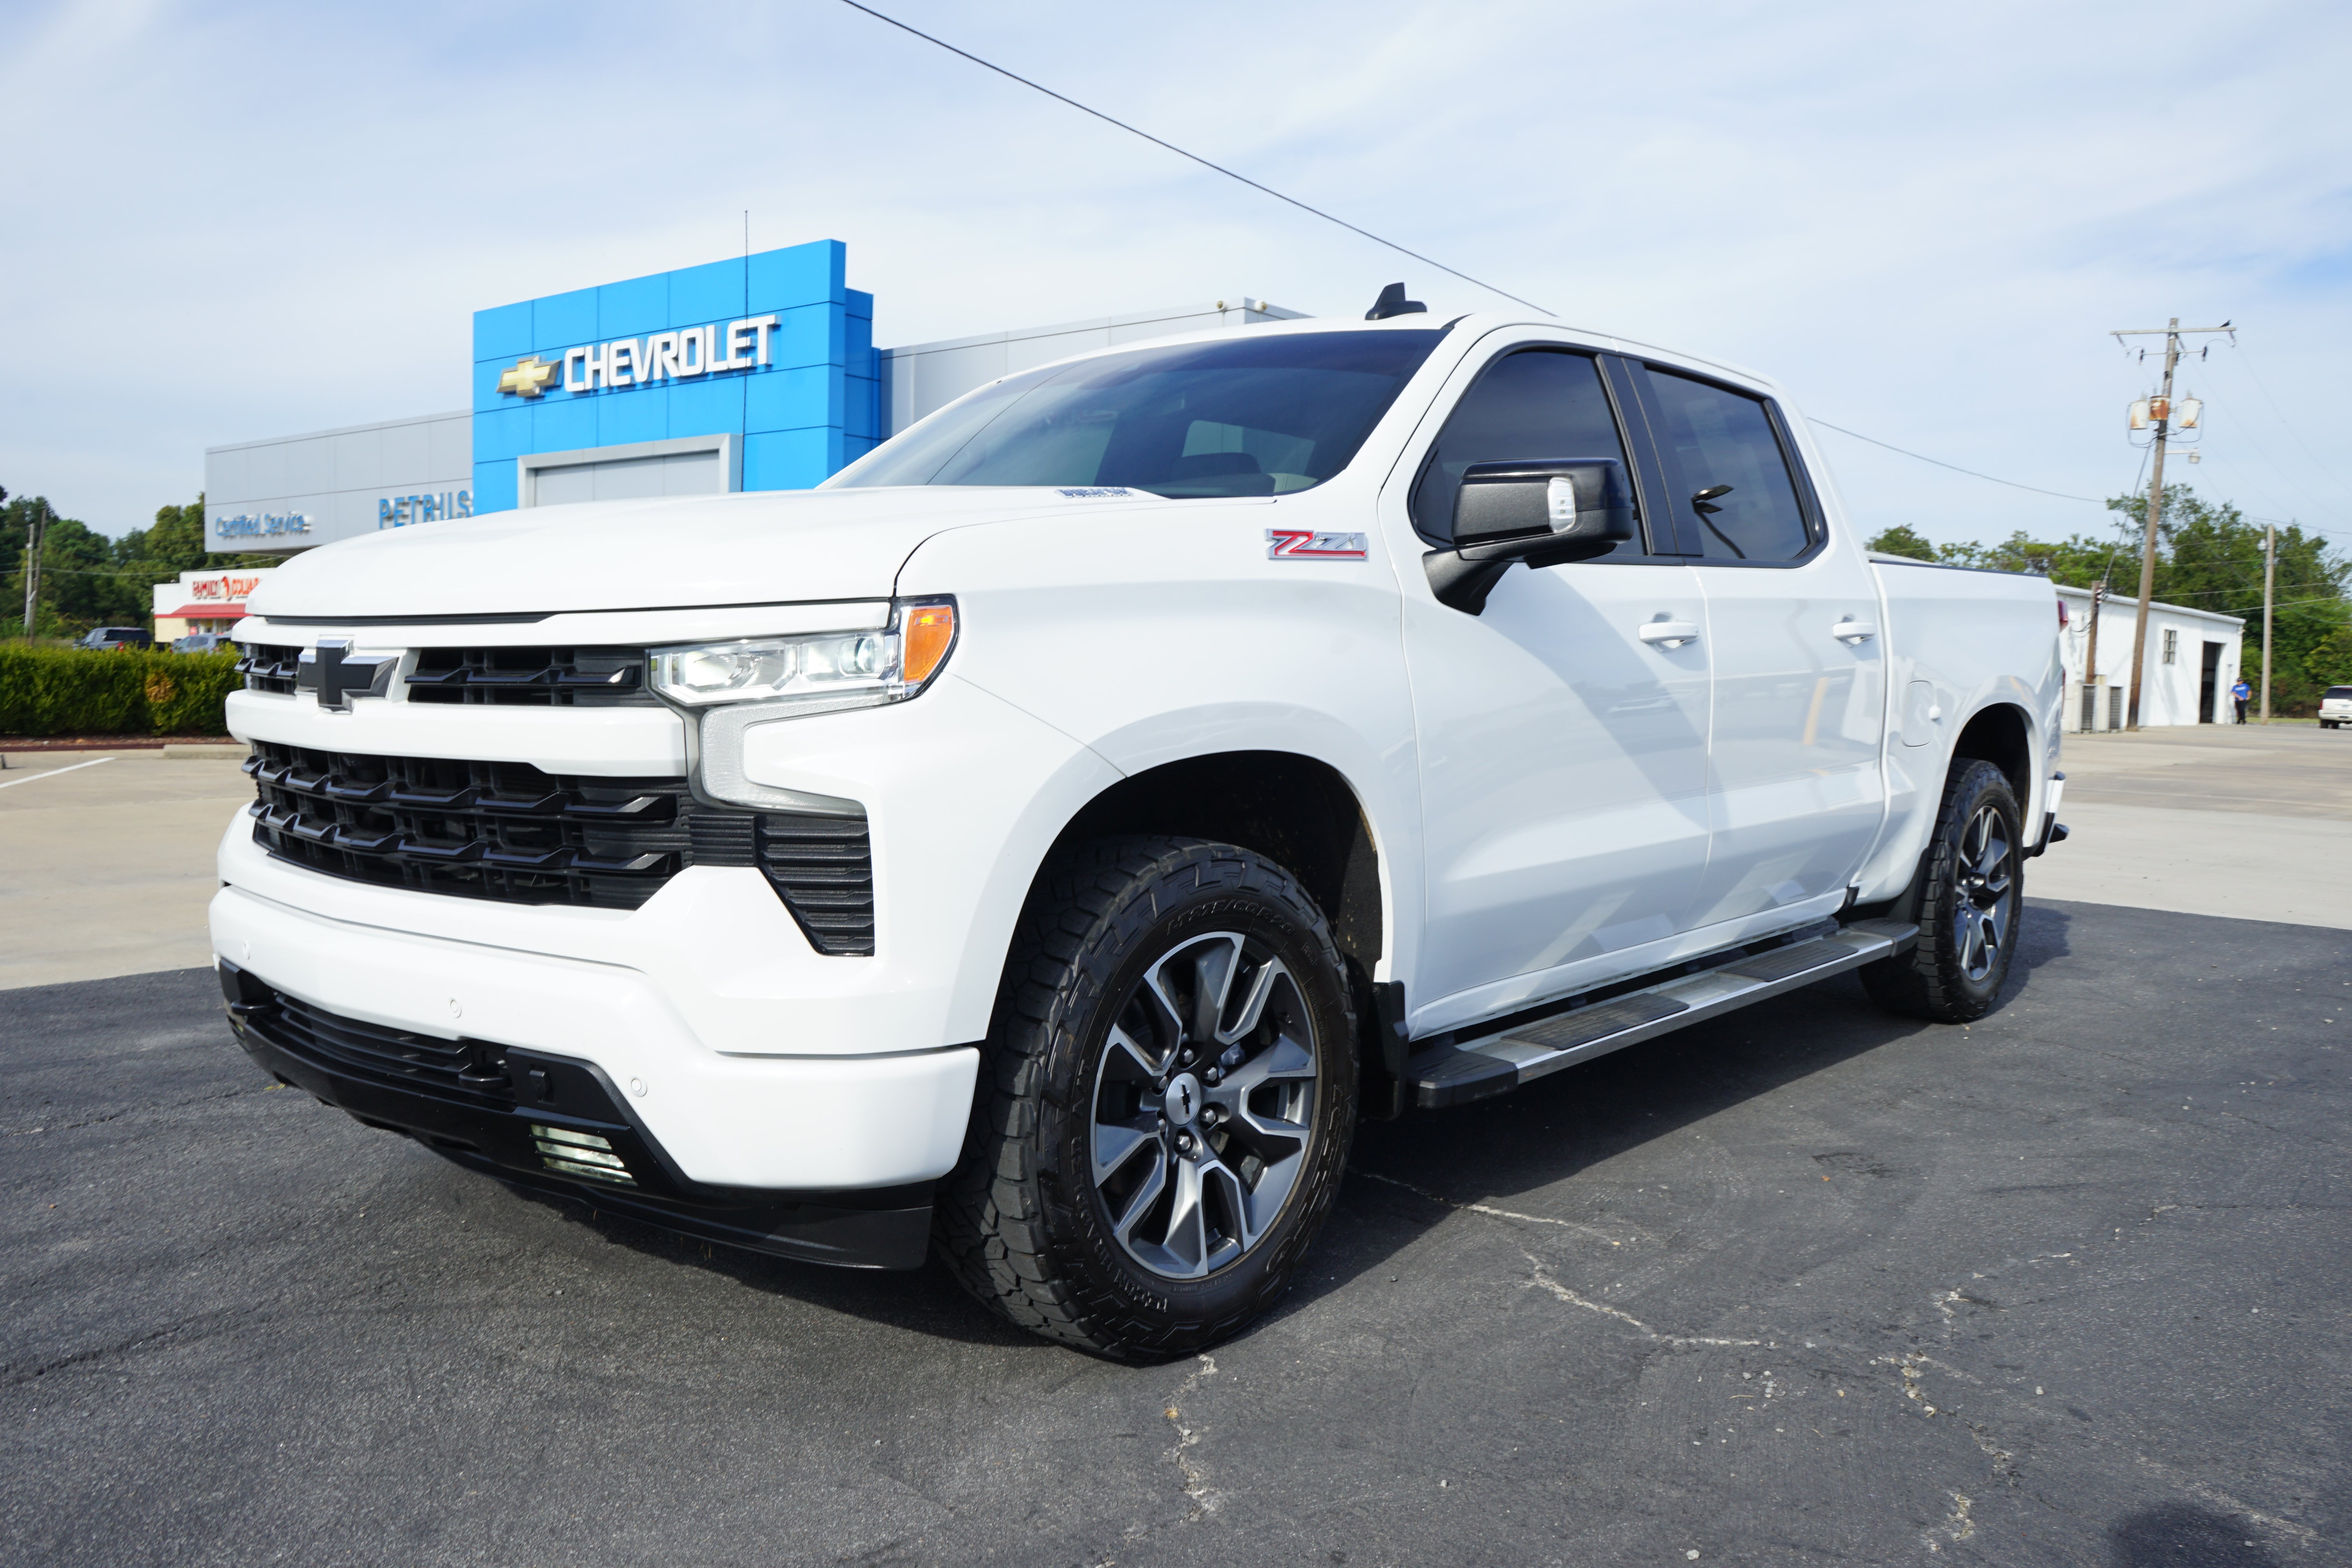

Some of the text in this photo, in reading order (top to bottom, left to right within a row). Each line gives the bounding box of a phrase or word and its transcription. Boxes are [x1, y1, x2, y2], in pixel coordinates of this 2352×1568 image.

[564, 315, 778, 392] CHEVROLET
[216, 511, 306, 536] Certified Service
[379, 490, 470, 528] PETRUS
[1266, 529, 1366, 560] Z71
[192, 580, 221, 596] FAMILY
